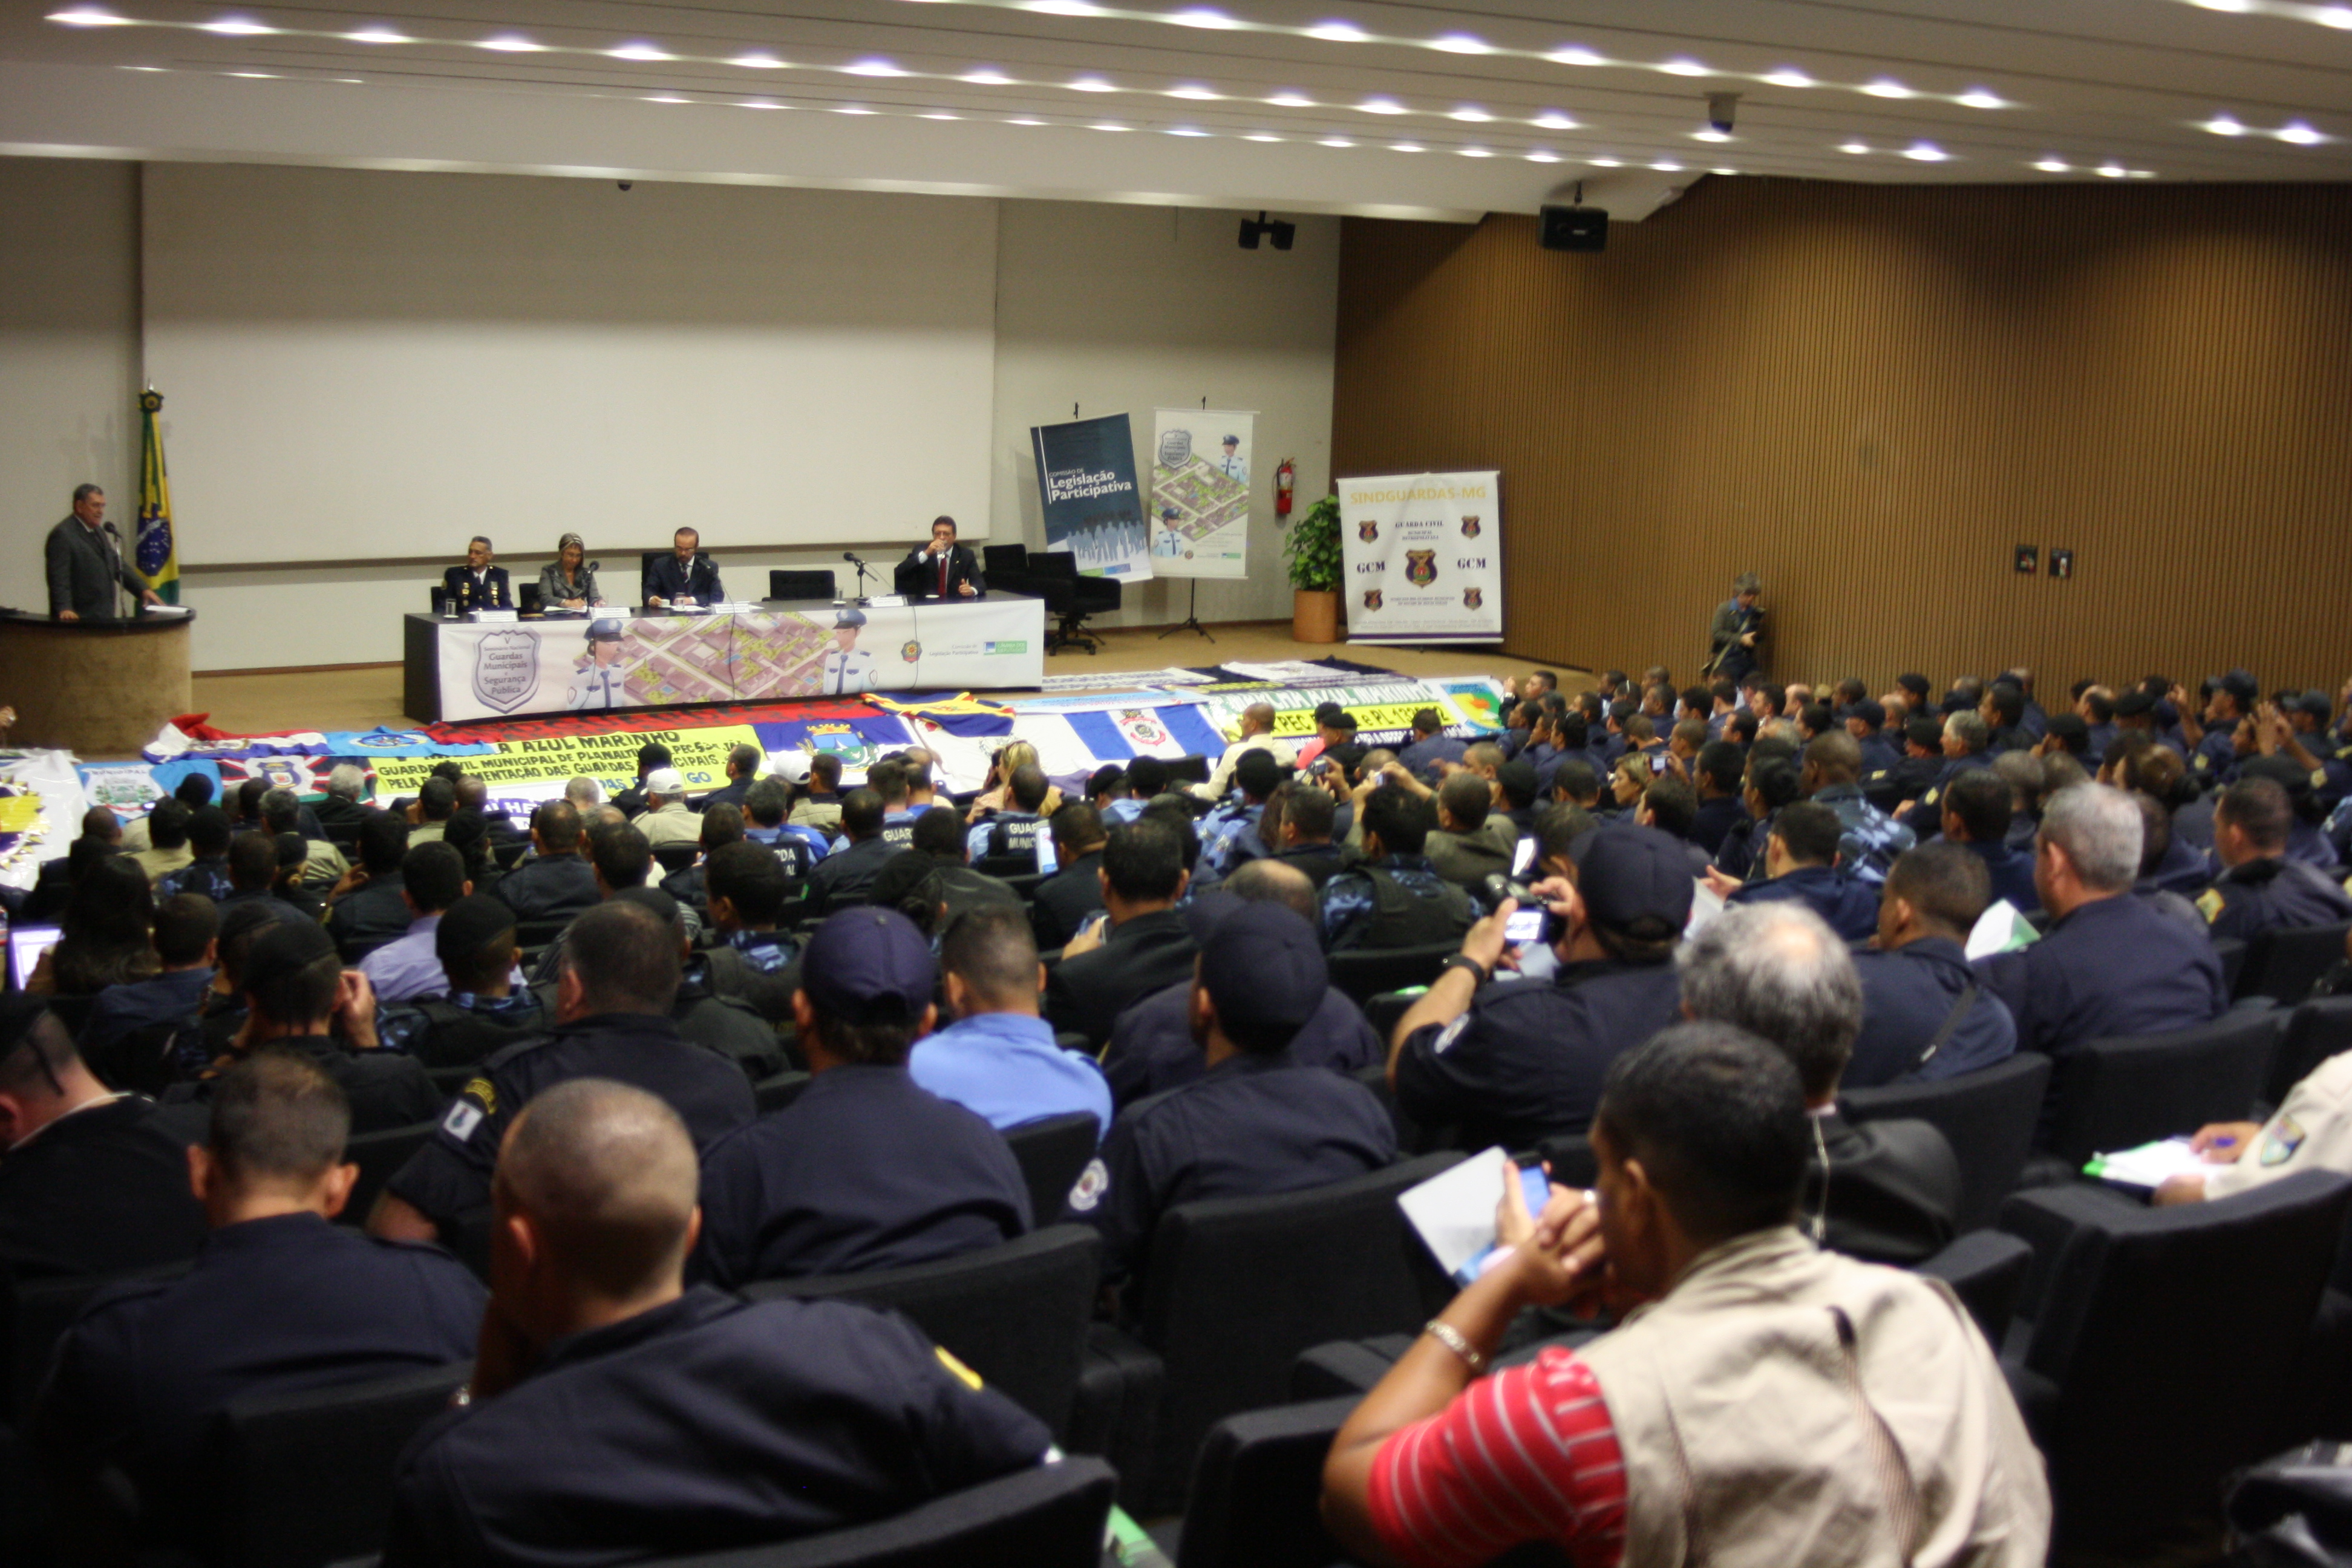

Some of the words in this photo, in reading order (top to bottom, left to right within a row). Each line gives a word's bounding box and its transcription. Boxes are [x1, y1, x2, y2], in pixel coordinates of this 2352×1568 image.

[1050, 470, 1115, 489] Legislação
[1051, 481, 1132, 501] Participativa
[1350, 486, 1487, 505] SINDGUARDAS-MG
[1357, 561, 1386, 573] GCM
[1457, 557, 1487, 569] GCM
[489, 652, 523, 661] Guardas
[484, 661, 528, 670] Municipais
[485, 676, 526, 685] Segurança
[492, 686, 521, 694] Pública
[1276, 714, 1312, 731] PEC
[1369, 709, 1395, 725] PL
[522, 737, 575, 753] AZUL
[578, 731, 681, 749] MARINHO
[481, 754, 556, 768] MUNICIPAL
[558, 753, 574, 762] DE
[386, 777, 421, 789] PELA
[545, 765, 572, 776] DAS
[574, 761, 635, 774] GUARDAS
[686, 771, 712, 783] GO
[883, 828, 913, 842] GUAR
[1008, 822, 1037, 835] GUAR
[1008, 837, 1037, 850] MUNIC
